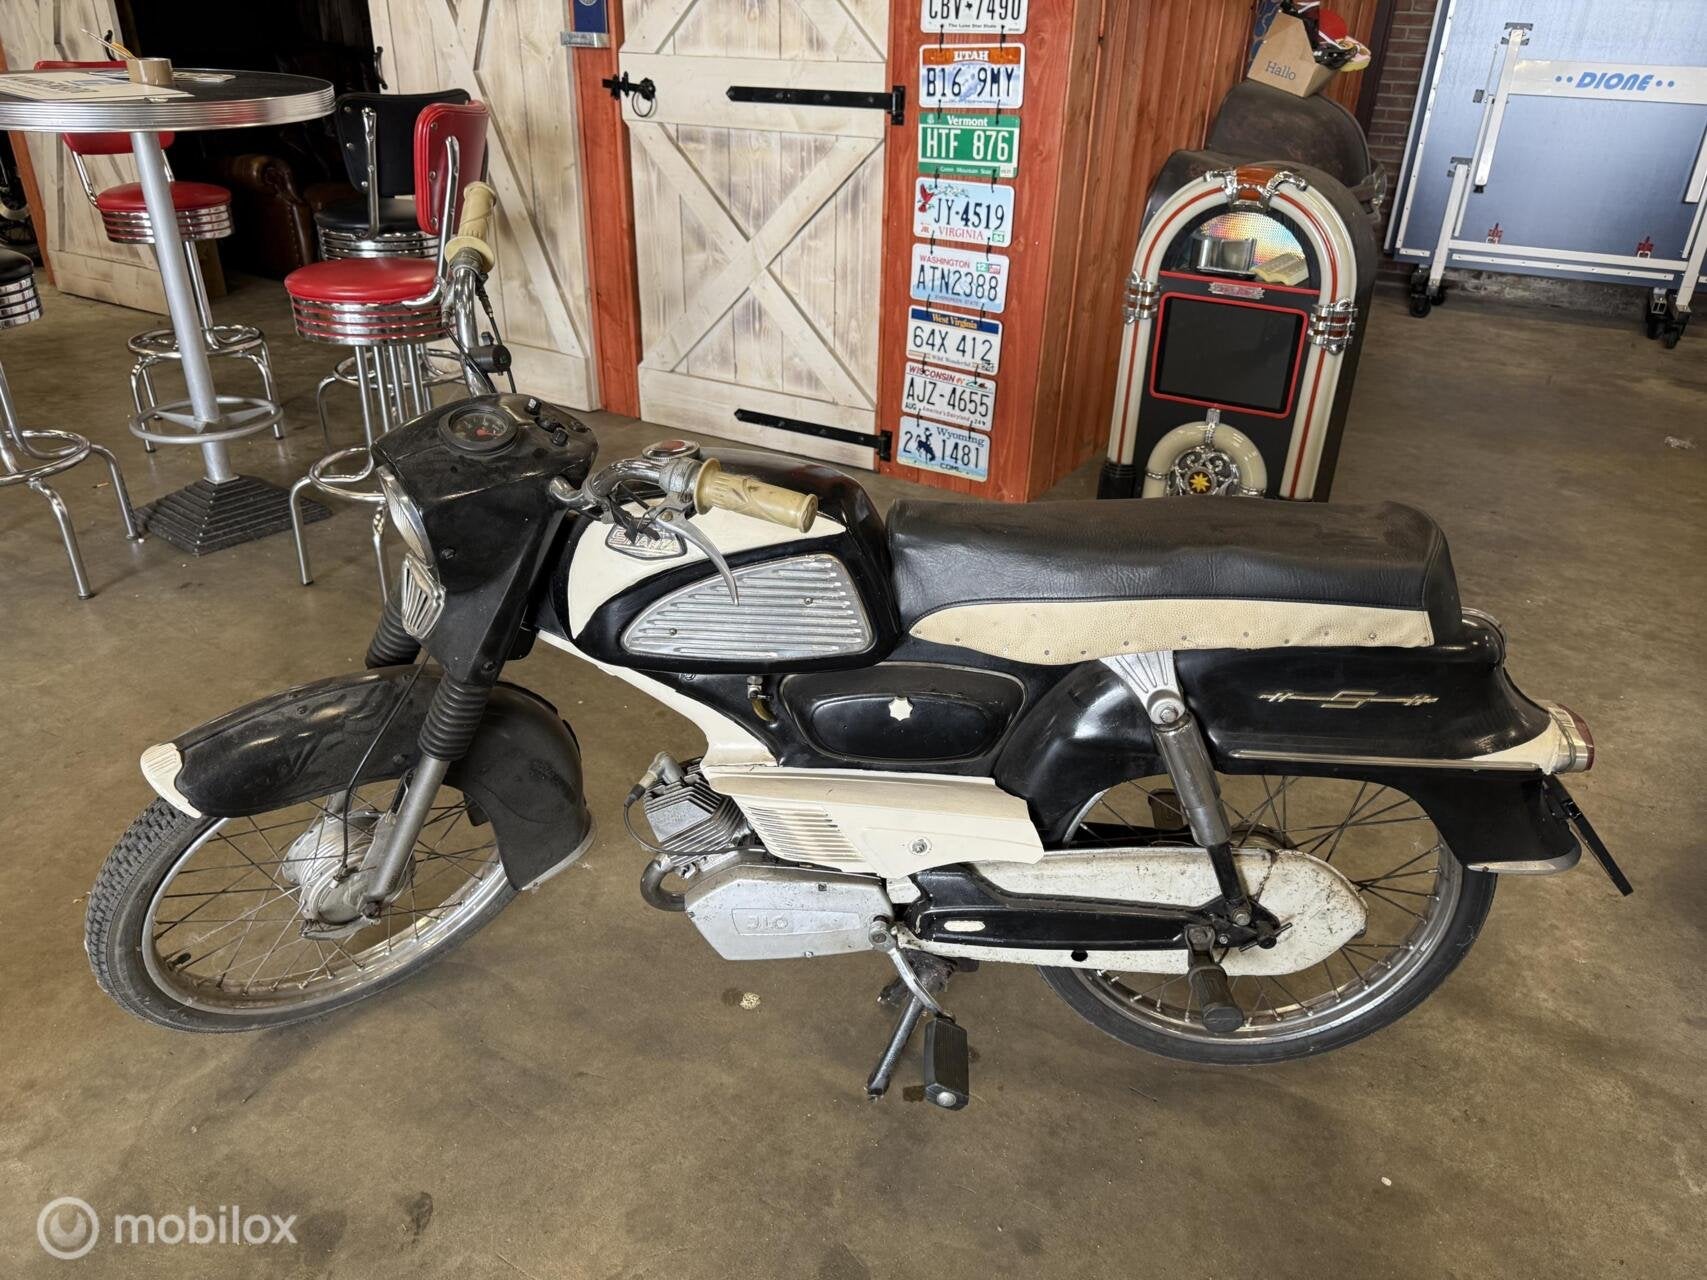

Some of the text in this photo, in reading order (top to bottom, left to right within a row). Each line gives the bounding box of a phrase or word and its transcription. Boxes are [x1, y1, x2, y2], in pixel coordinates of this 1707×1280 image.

[929, 0, 963, 19] CBV
[953, 51, 989, 62] UTAH
[1265, 60, 1297, 81] Hallo
[926, 67, 1015, 98] B16 9MY
[1575, 72, 1655, 91] DIONE
[947, 115, 988, 127] Vermont
[926, 128, 1010, 161] HTF 876
[934, 198, 1005, 230] JY-4519
[938, 226, 984, 241] VIRGINIA
[920, 255, 970, 269] WASHINGTON
[916, 264, 999, 301] ATN2388
[932, 313, 978, 329] West Virginia
[913, 325, 993, 363] 64X 412
[909, 365, 955, 382] WISCONSIN
[906, 376, 990, 418] AJZ-4655
[903, 431, 980, 468] 2 1481
